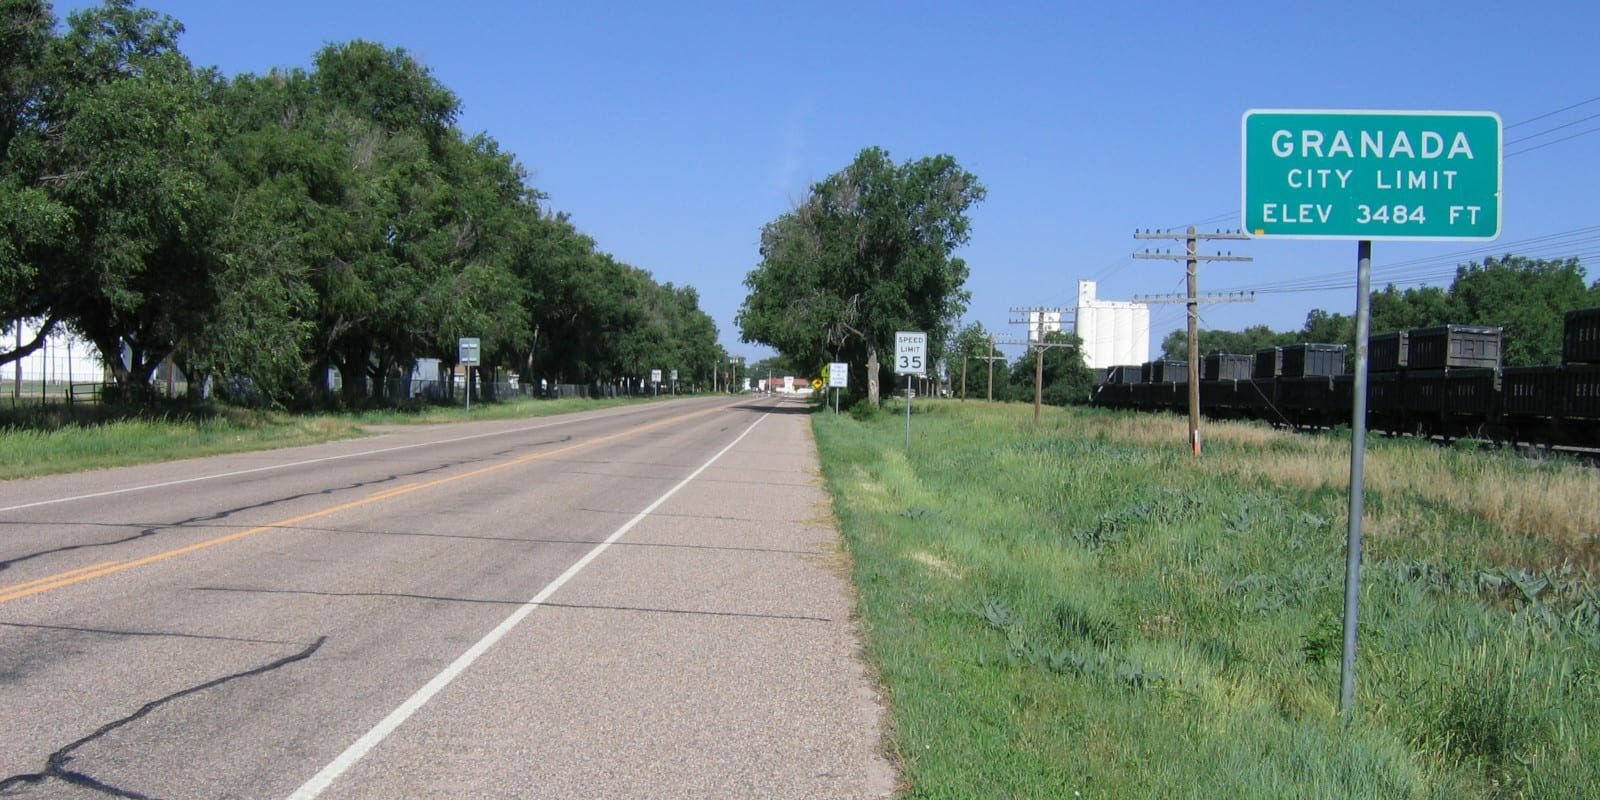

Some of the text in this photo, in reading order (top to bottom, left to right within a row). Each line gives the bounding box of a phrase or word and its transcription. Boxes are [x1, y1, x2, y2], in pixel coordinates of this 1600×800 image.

[1271, 129, 1474, 159] GRANADA
[1287, 168, 1457, 189] CITY LIMIT
[1263, 203, 1481, 225] ELEV 3484 FT
[899, 355, 922, 369] 35
